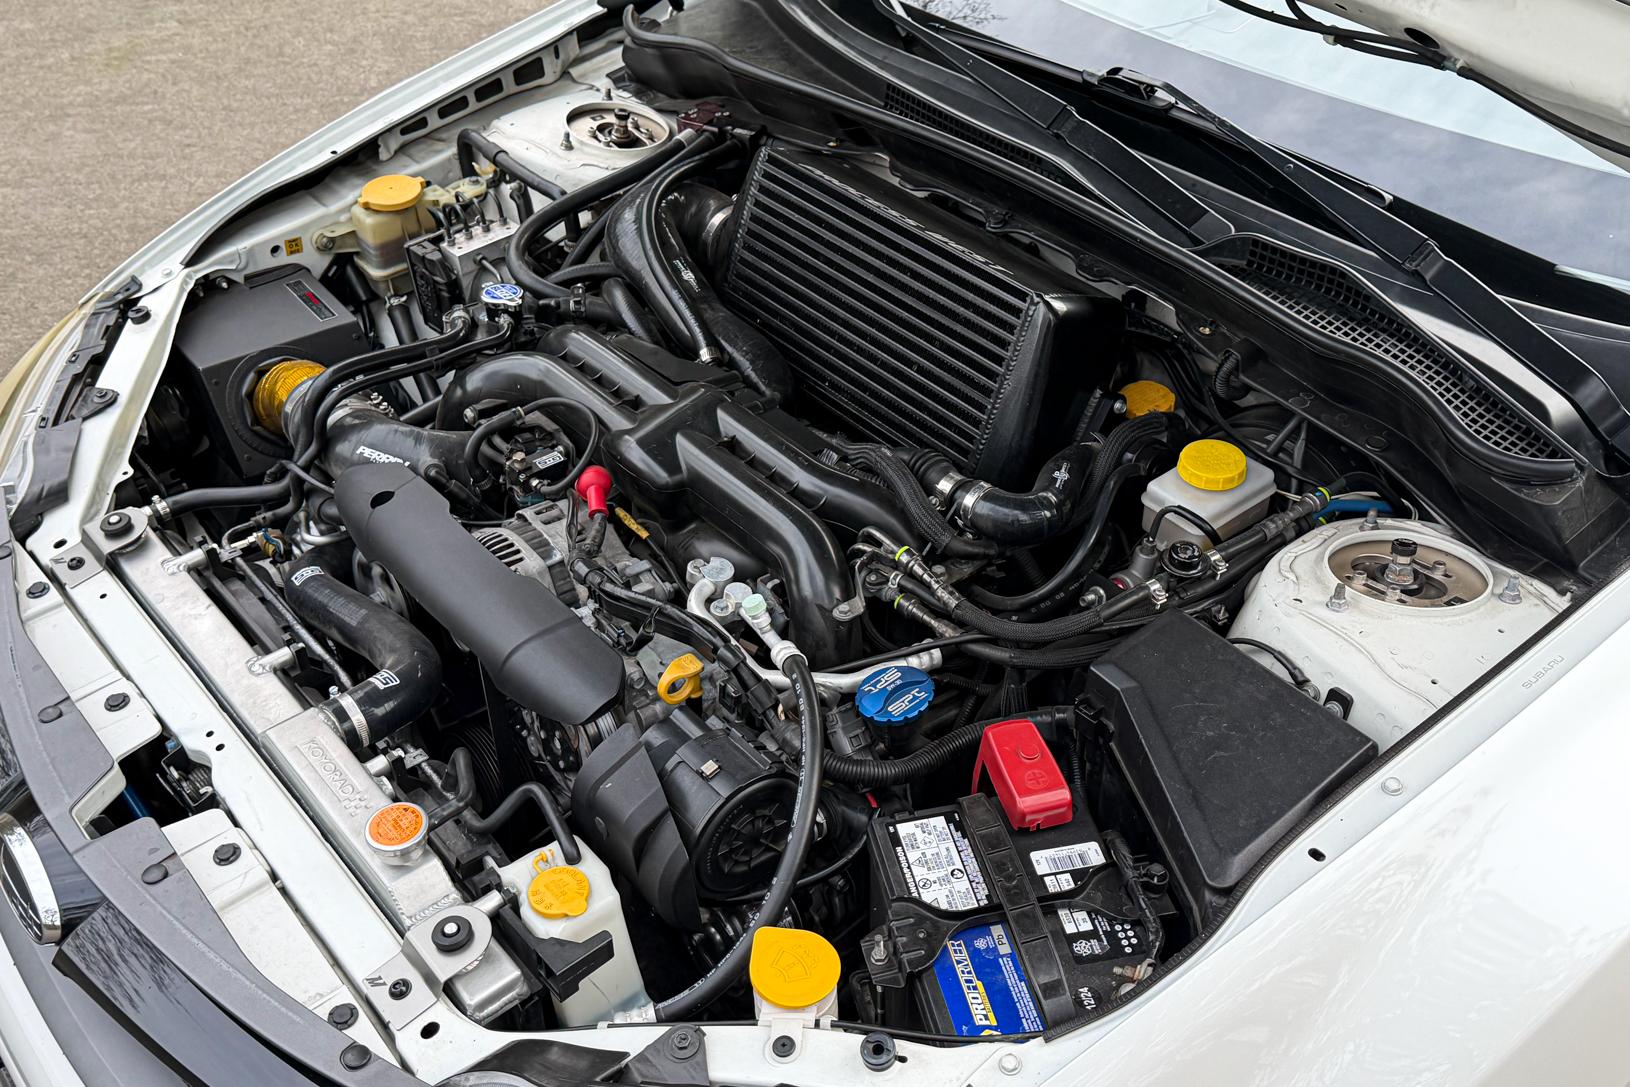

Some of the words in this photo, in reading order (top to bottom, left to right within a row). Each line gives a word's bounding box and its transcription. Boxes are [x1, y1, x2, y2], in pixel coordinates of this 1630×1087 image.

[356, 446, 411, 466] PERR
[1521, 655, 1565, 689] SUBARU
[301, 741, 355, 795] KOYORAD
[895, 846, 919, 898] ANGER/POISON
[997, 934, 1007, 947] Pb
[948, 940, 992, 1026] PROFORMER
[1077, 986, 1097, 1010] 12/24
